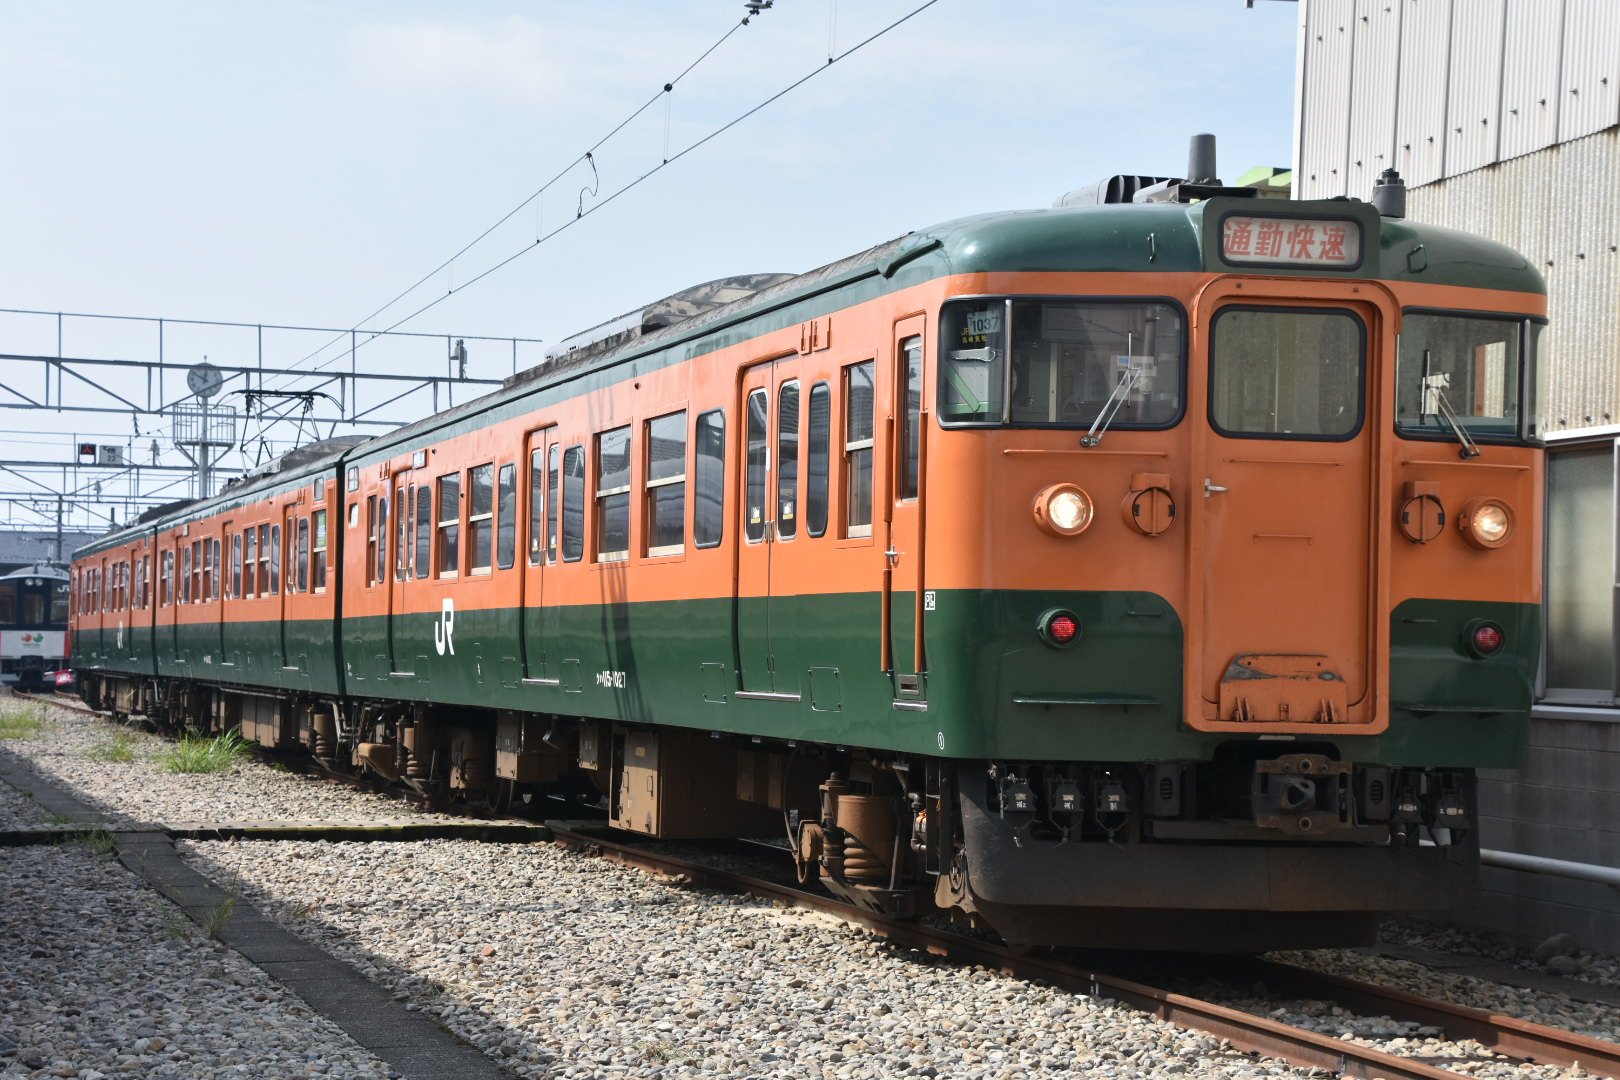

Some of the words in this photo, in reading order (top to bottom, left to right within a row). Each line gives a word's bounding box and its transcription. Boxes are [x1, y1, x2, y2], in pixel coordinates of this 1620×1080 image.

[1224, 219, 1345, 261] 通勤快速
[434, 597, 455, 656] JR
